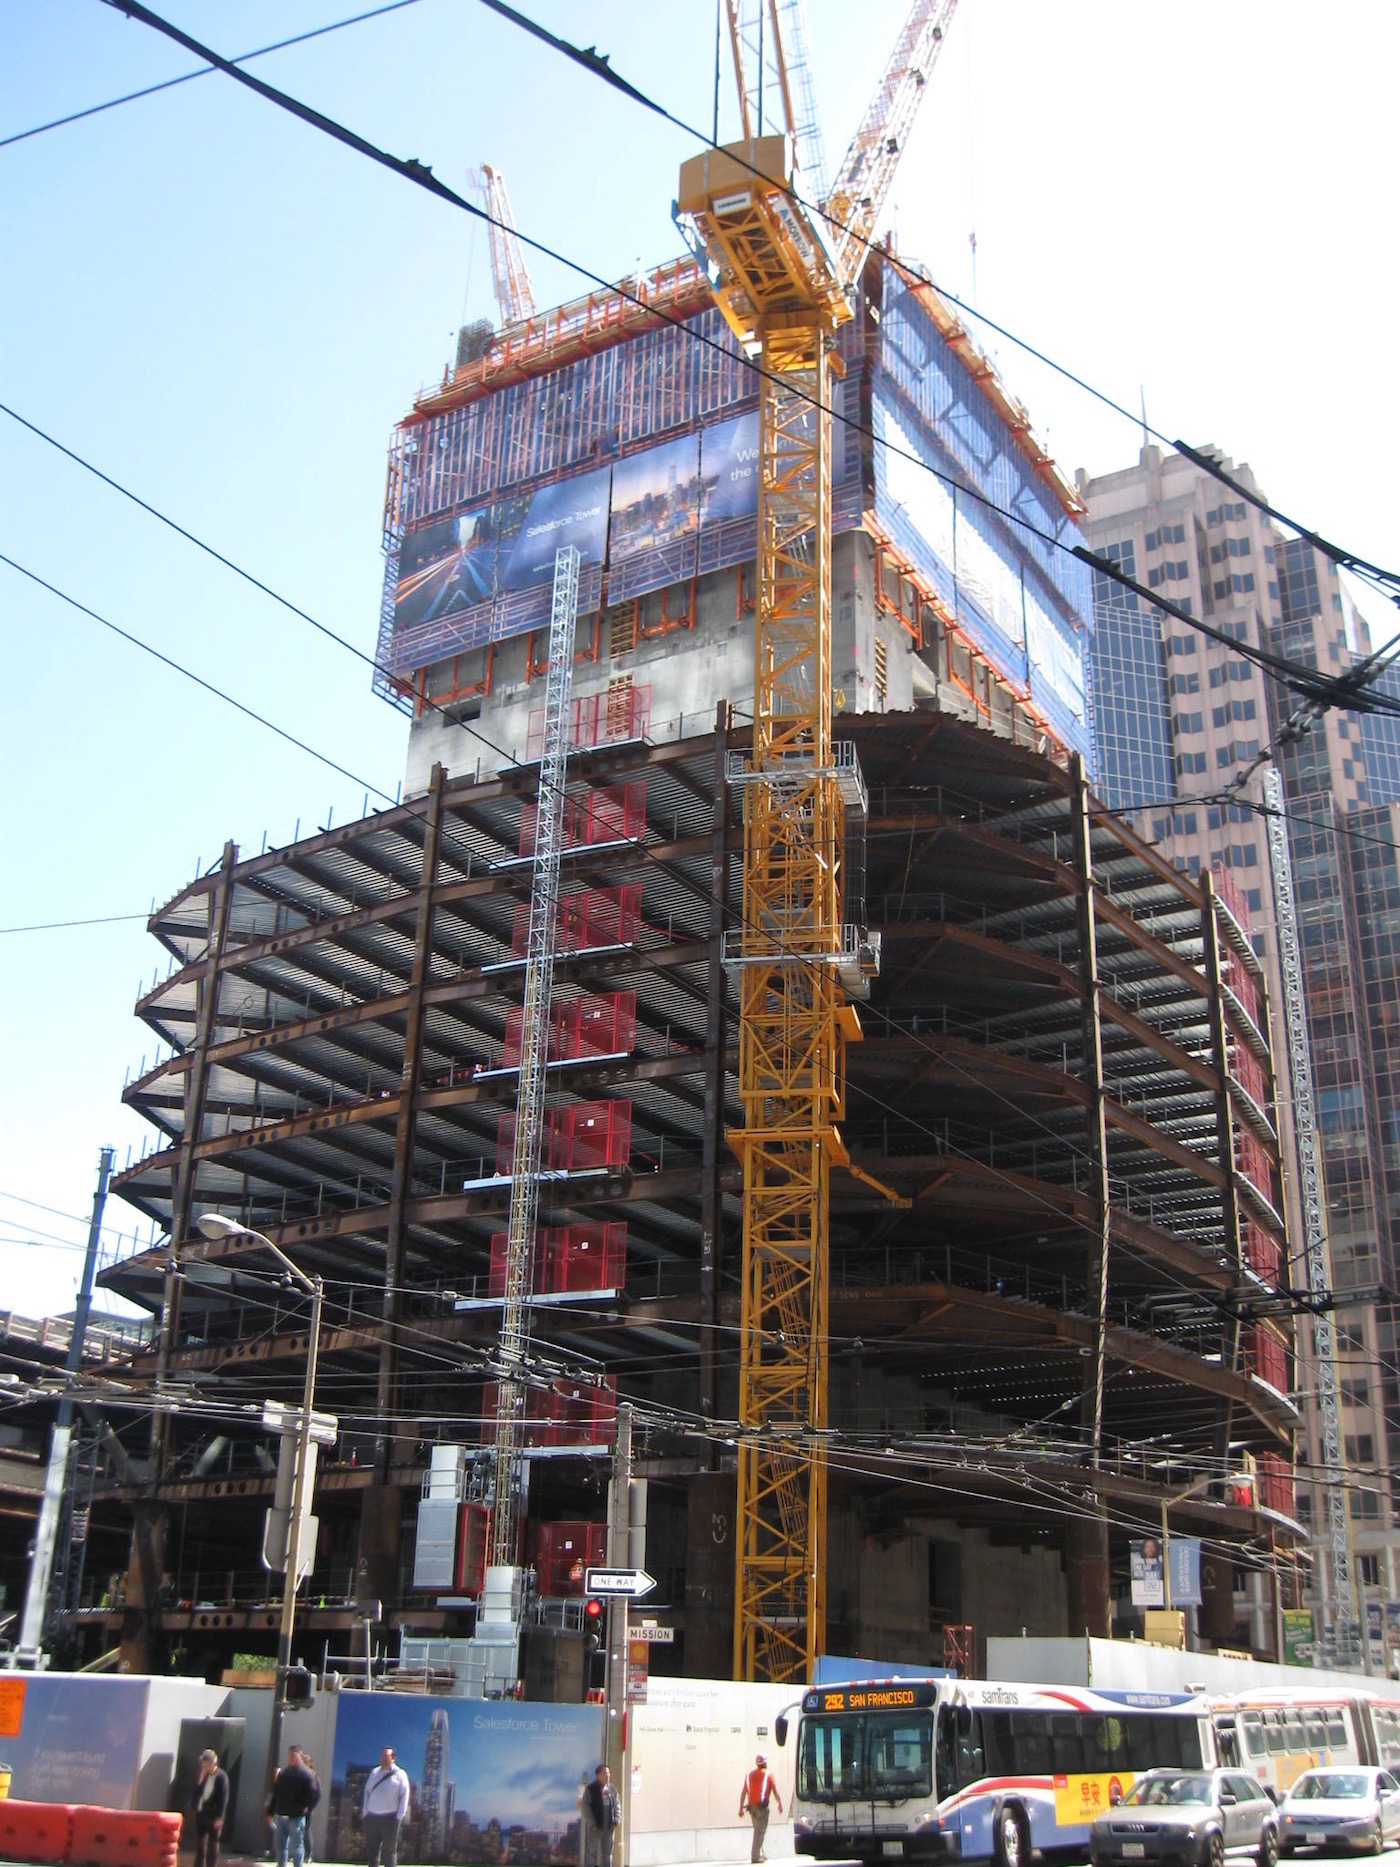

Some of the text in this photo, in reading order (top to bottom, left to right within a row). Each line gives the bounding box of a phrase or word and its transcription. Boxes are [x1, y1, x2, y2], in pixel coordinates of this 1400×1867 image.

[731, 465, 751, 481] the
[526, 506, 602, 538] Salesforce Tower
[594, 1577, 634, 1586] ONE WAY
[630, 1629, 670, 1640] MISSION
[825, 1691, 914, 1710] 292 SAN FRANCISCO
[474, 1715, 577, 1732] Salesforce Tower
[1081, 1782, 1100, 1806] 早安
